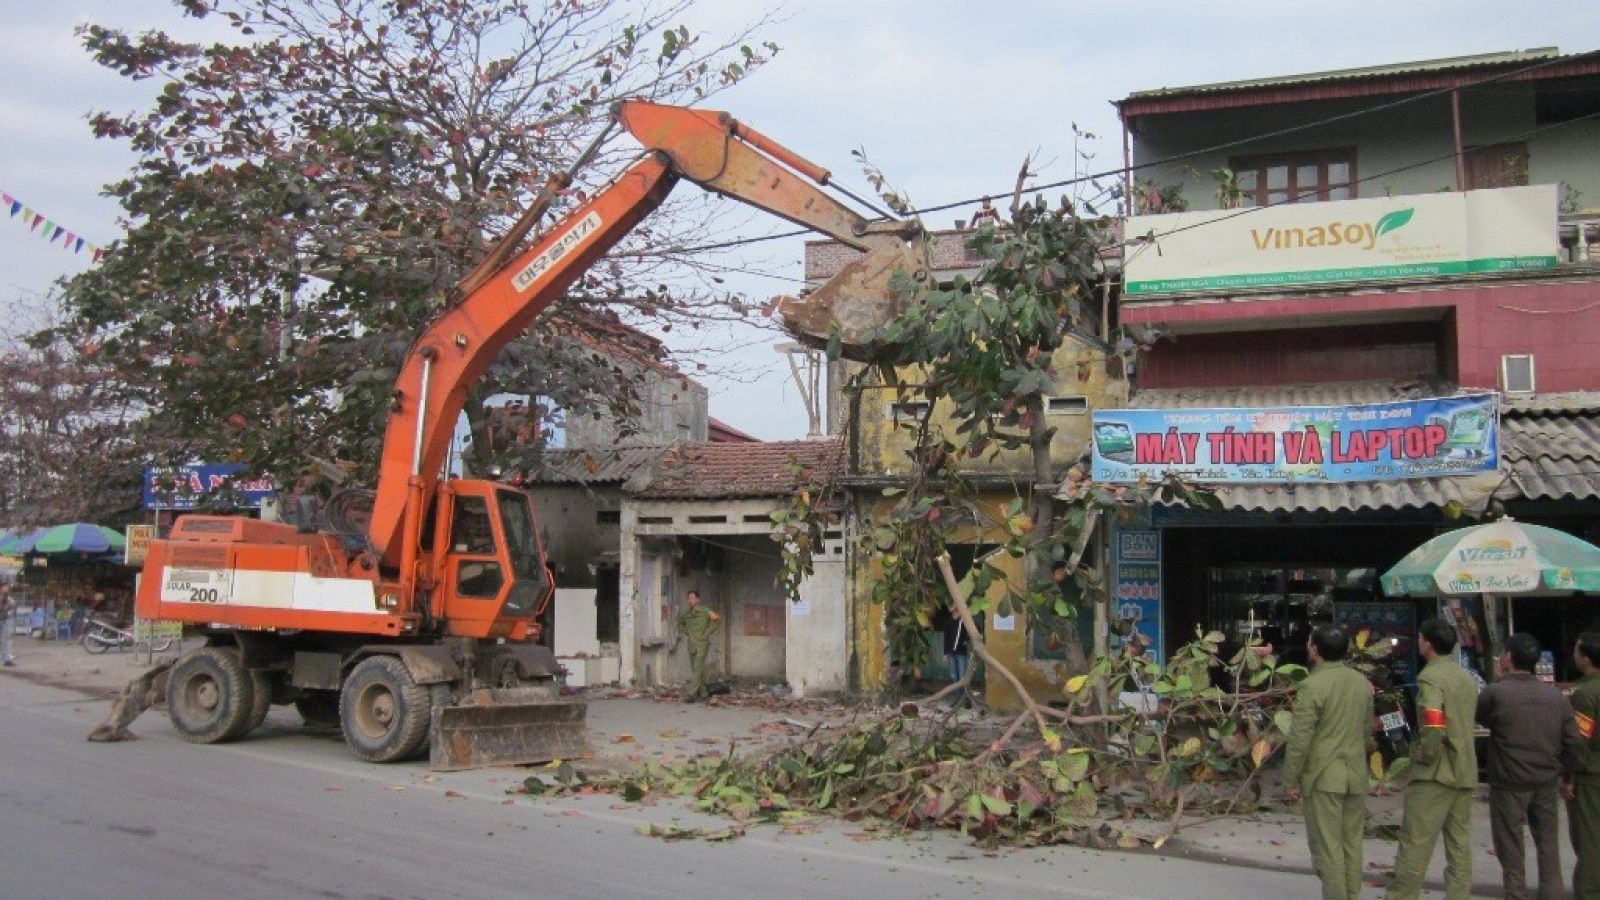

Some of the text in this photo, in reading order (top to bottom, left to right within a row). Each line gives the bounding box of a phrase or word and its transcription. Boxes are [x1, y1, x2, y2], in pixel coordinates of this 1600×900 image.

[1136, 425, 1446, 465] MÁY TÍNH VÀ LAPTOP
[190, 588, 218, 602] 200
